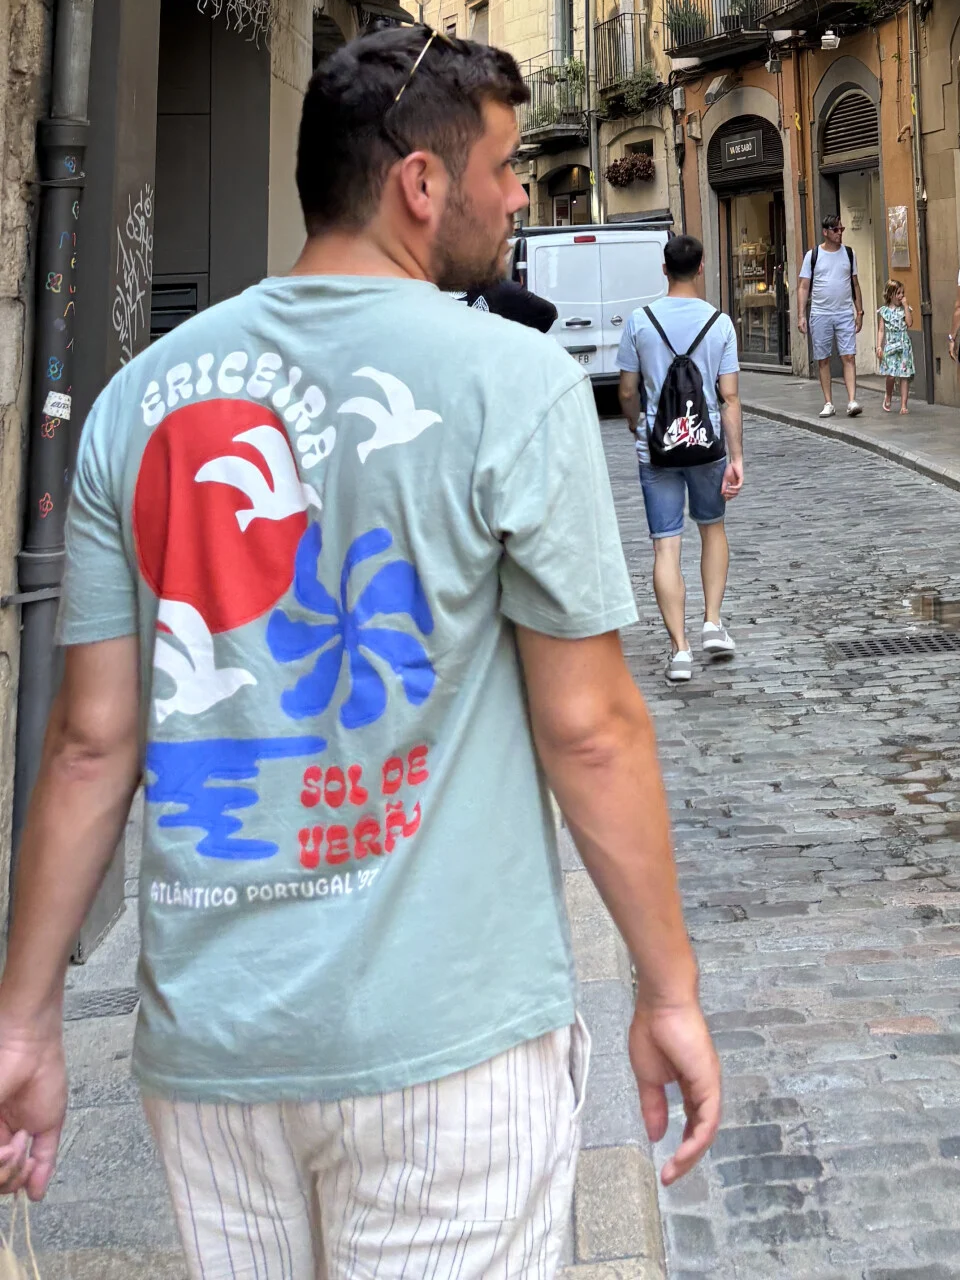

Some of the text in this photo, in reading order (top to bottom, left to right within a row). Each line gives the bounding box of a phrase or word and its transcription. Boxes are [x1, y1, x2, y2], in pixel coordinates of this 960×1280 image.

[140, 351, 336, 470] ERICEIRA
[300, 745, 429, 808] SOL DE
[247, 872, 353, 902] PORTUGAL
